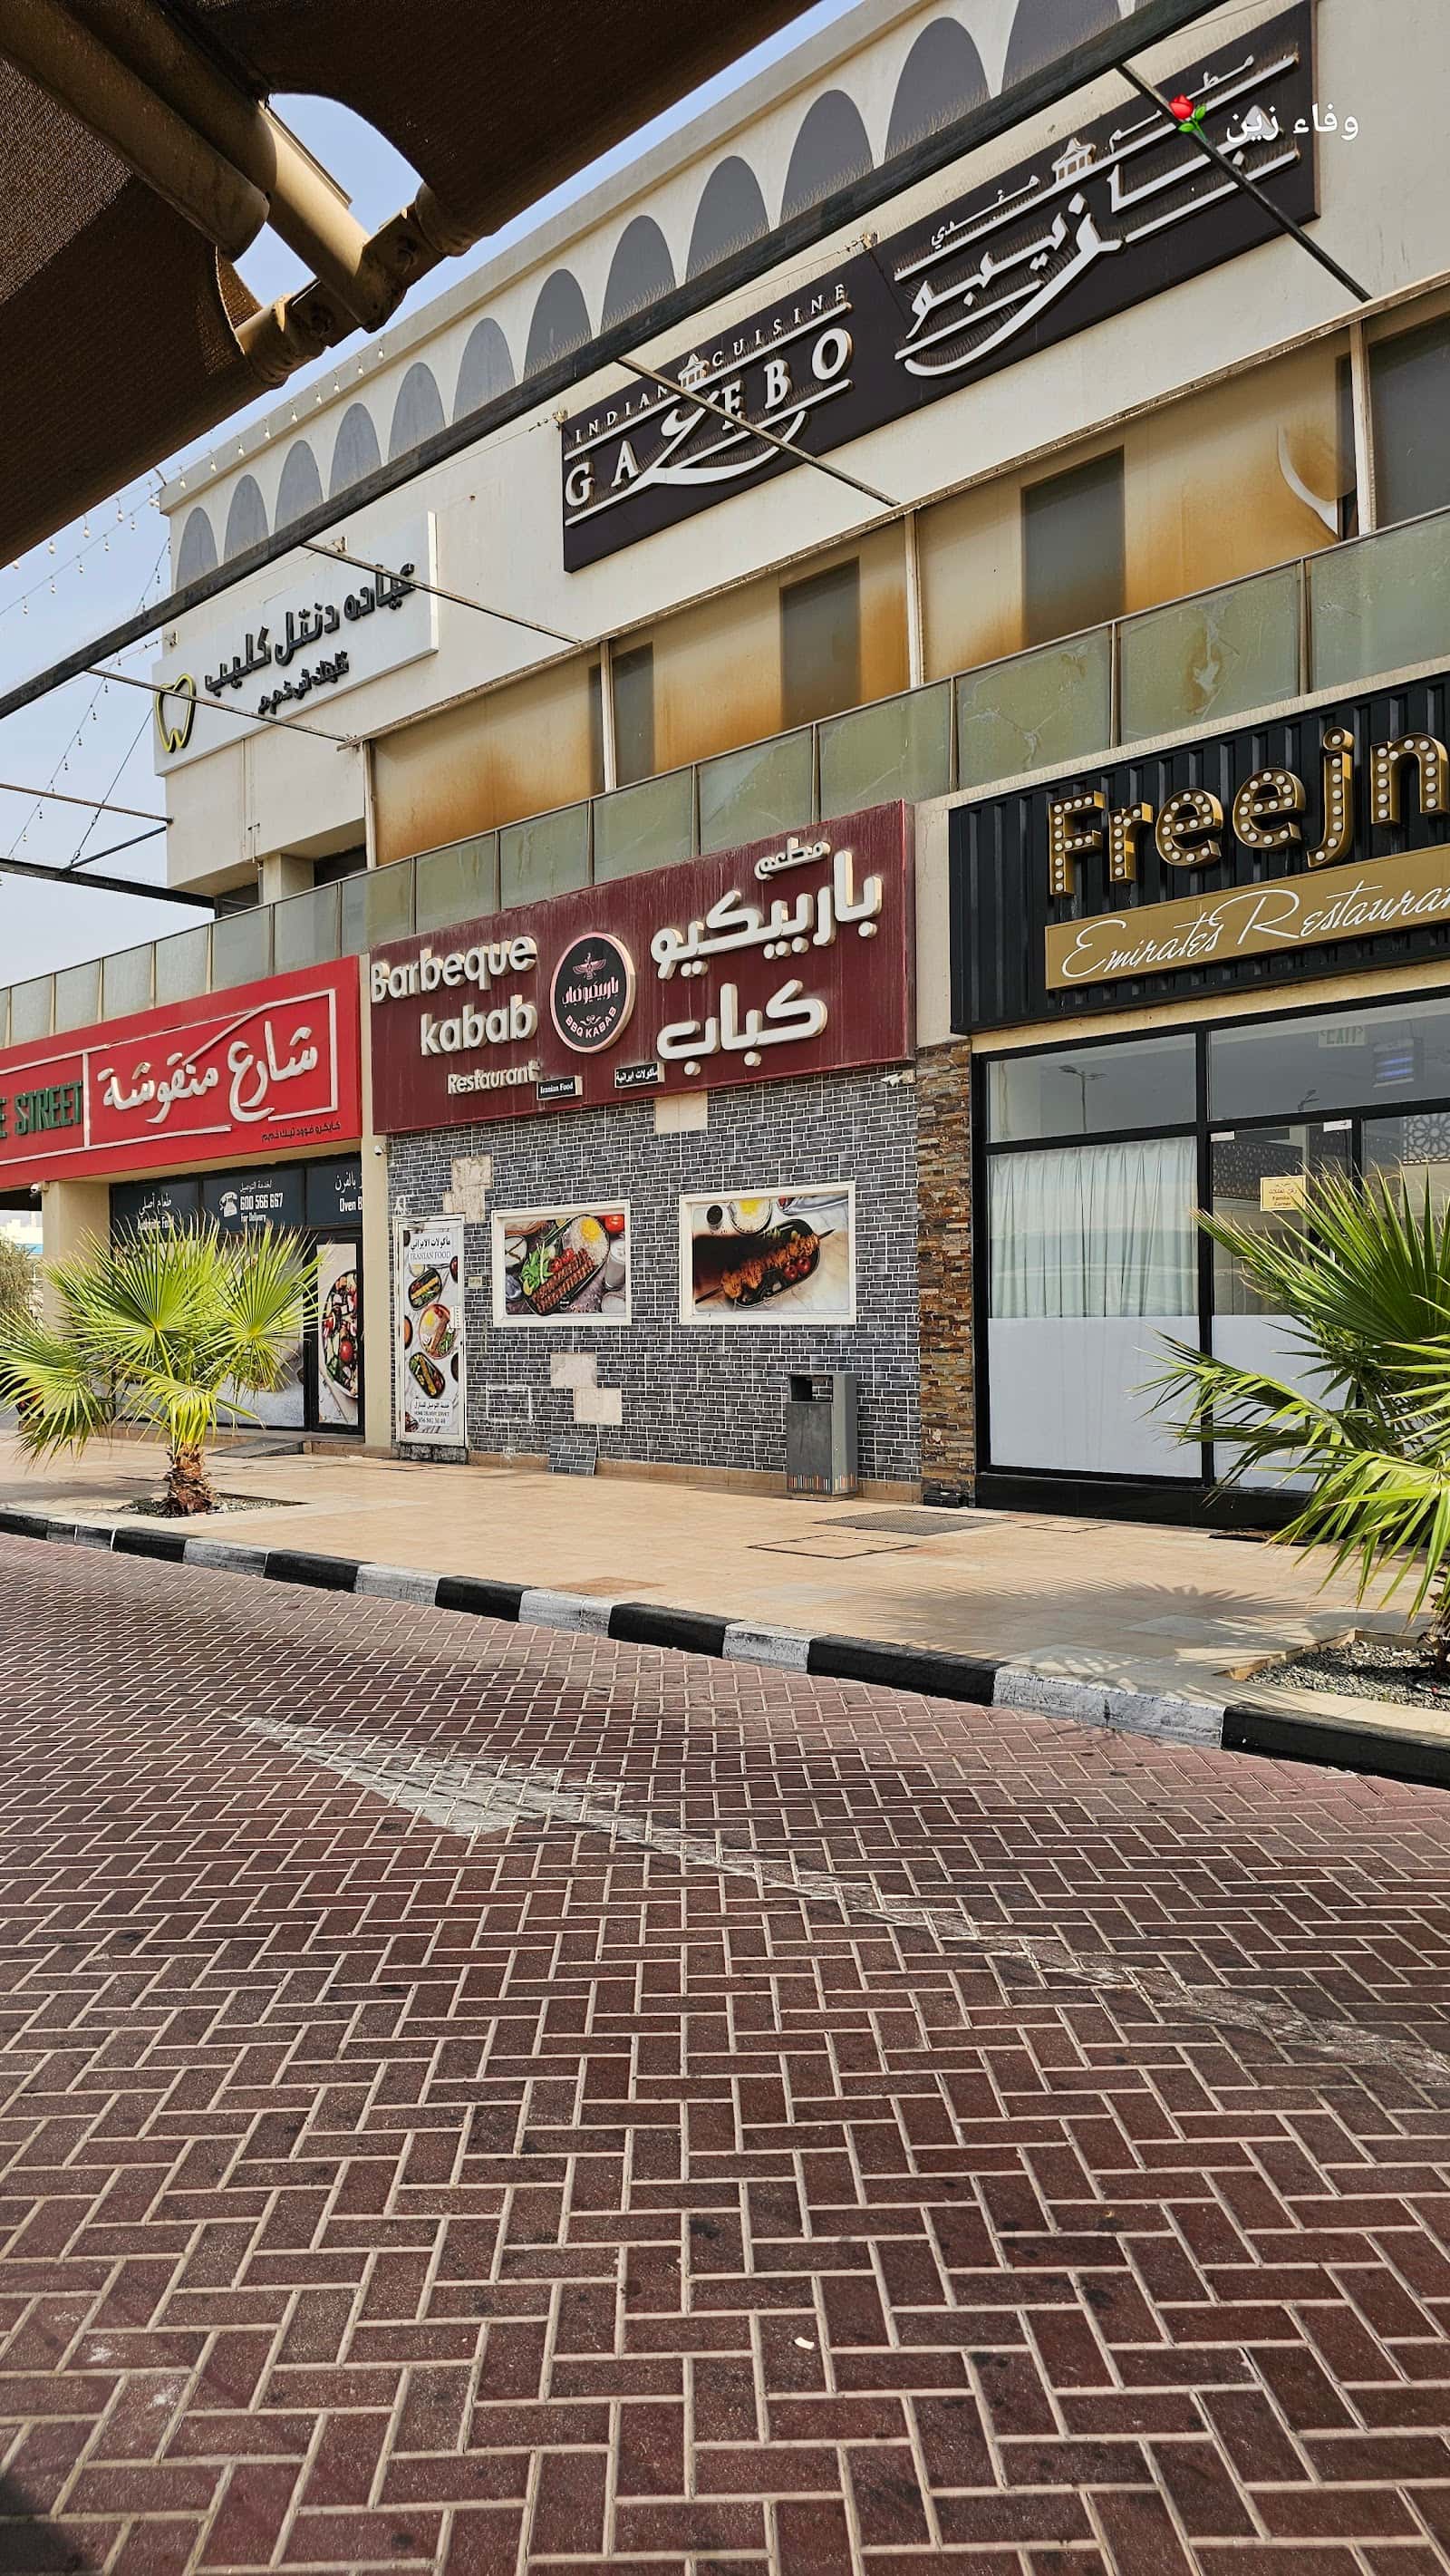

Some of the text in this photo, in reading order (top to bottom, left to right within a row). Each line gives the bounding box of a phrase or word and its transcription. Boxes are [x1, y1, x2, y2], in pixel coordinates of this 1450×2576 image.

[575, 283, 849, 443] INDIAN CUISINE
[565, 327, 854, 508] GAZEBO
[754, 837, 831, 882] مطعم
[650, 850, 884, 981] باربيكيو
[1061, 911, 1224, 979] Emirates
[371, 935, 538, 1003] Barbeque
[420, 993, 538, 1057] kabab
[566, 1006, 617, 1039] BBQ KABAB
[657, 979, 828, 1077] كباب
[97, 1051, 219, 1125] منقوشة
[228, 1021, 319, 1124] شارع
[447, 1059, 544, 1095] Restaurant
[560, 1081, 574, 1091] Food
[14, 1080, 83, 1136] STREET
[240, 1195, 254, 1211] 600
[339, 1197, 357, 1213] Oven
[434, 1251, 451, 1260] FOOD
